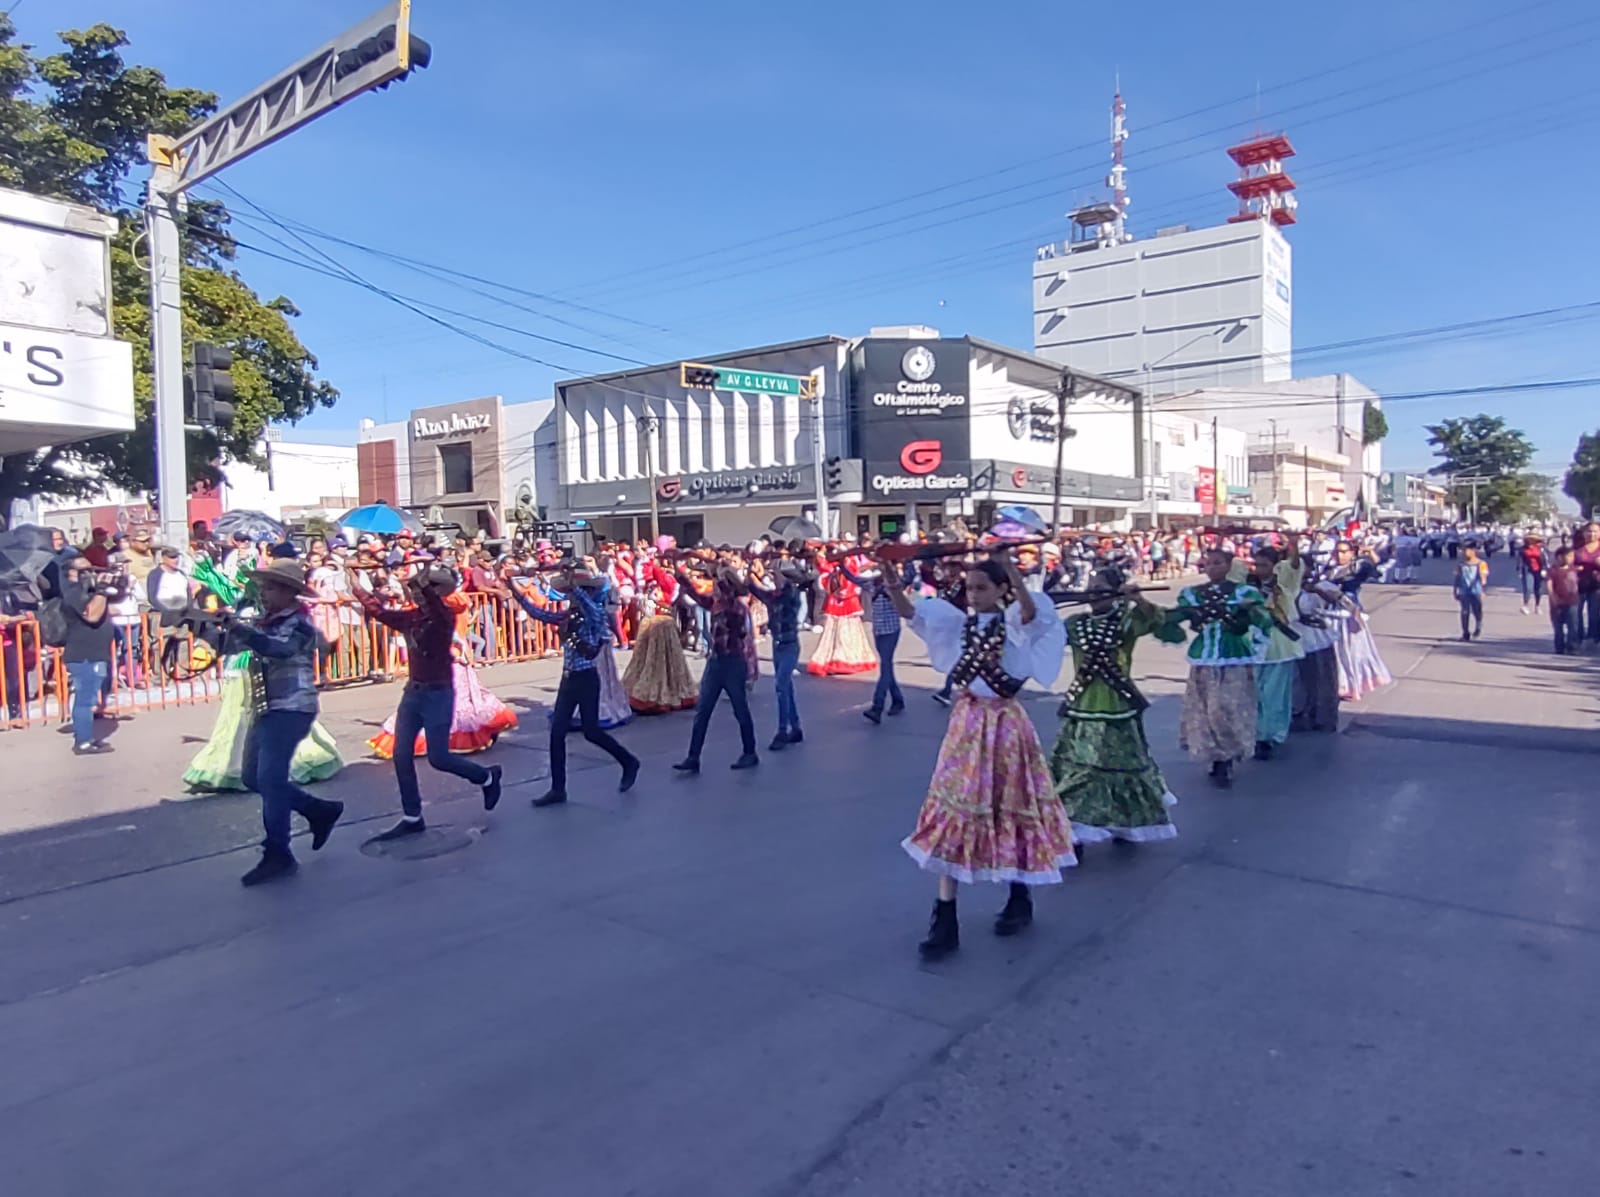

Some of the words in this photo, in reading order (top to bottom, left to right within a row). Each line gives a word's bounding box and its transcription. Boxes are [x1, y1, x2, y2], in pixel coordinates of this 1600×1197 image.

[727, 374, 741, 386] AV
[744, 375, 752, 387] G
[755, 377, 789, 392] LEYVA
[897, 381, 941, 393] Centro
[873, 393, 965, 408] Oftalmológico
[692, 474, 747, 495] Opticas
[872, 475, 924, 495] Opticas
[925, 473, 969, 489] García
